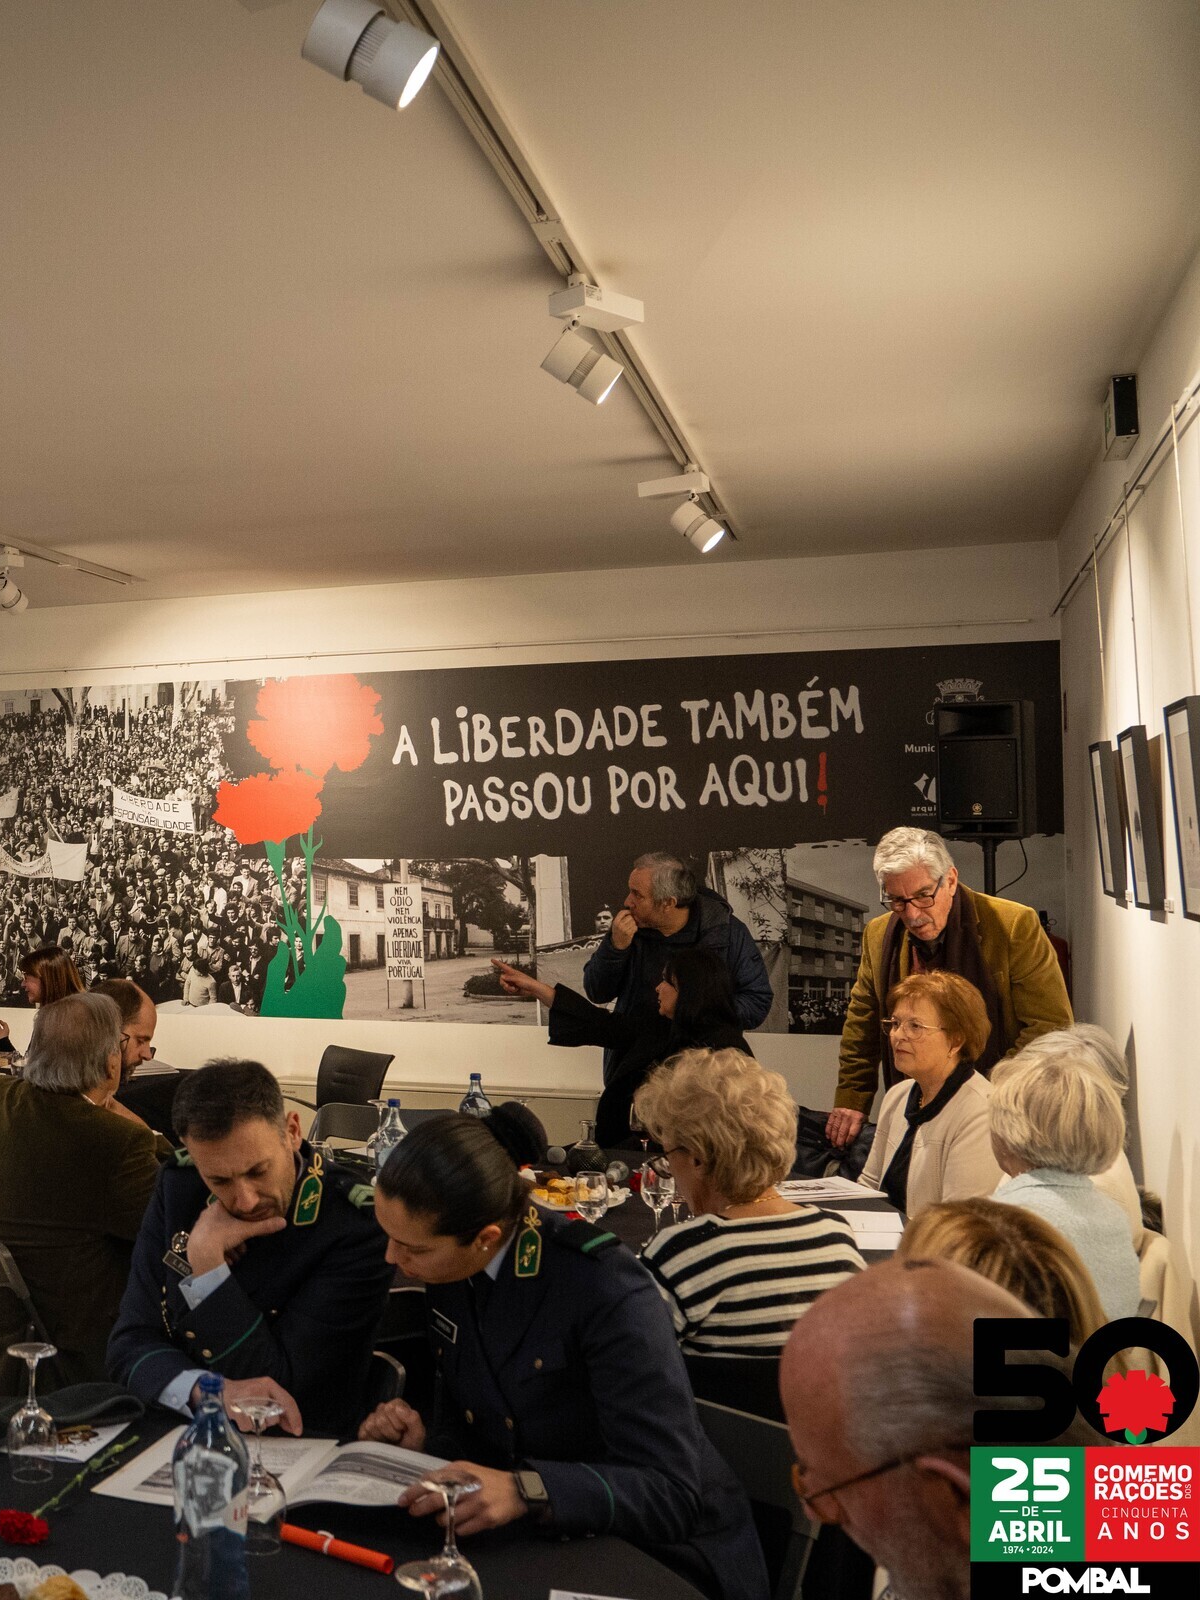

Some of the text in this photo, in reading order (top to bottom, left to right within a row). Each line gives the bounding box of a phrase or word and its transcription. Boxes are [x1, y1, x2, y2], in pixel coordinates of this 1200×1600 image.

[392, 724, 418, 766] A
[680, 675, 864, 744] TAMBÉM
[904, 743, 936, 753] Munic
[120, 792, 180, 813] LIBERDADE
[443, 771, 592, 827] PASSOU
[607, 765, 686, 815] POR
[911, 804, 937, 813] arqui
[113, 806, 194, 831] ESPONSABILIDADE
[394, 886, 408, 896] NEM
[395, 907, 410, 915] NEM
[392, 927, 418, 939] APENAS
[386, 940, 423, 959] LIBERDADE
[387, 965, 424, 978] PORTUGAL
